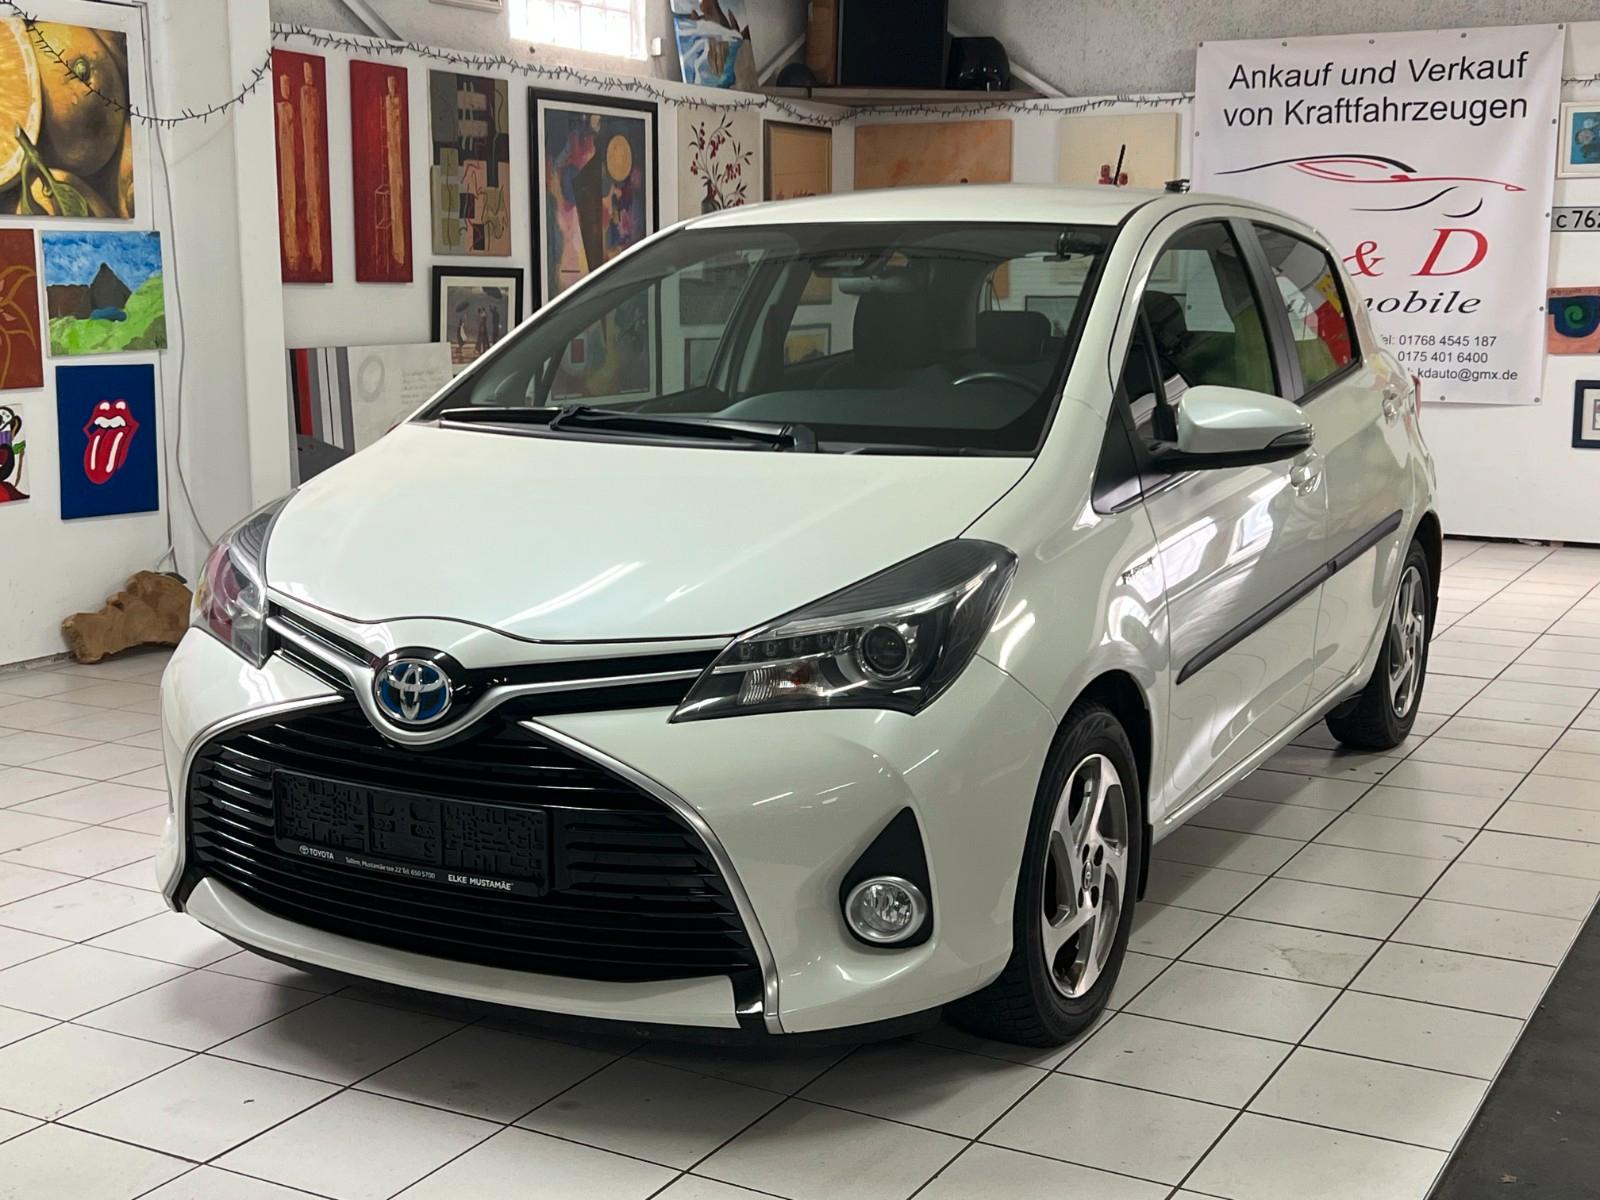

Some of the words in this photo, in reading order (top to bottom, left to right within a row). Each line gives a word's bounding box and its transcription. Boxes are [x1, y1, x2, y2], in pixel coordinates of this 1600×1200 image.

[1228, 62, 1334, 89] Ankauf
[1340, 60, 1397, 85] und
[1408, 51, 1529, 82] Verkauf
[1223, 106, 1273, 127] von
[1284, 96, 1527, 127] Kraftfahrzeugen
[1343, 240, 1386, 277] &
[1410, 228, 1488, 276] D
[1399, 334, 1436, 347] 01768
[1439, 335, 1470, 347] 4545
[1474, 336, 1497, 347] 187
[1398, 351, 1428, 362] 0175
[1431, 351, 1452, 363] 401
[1457, 352, 1488, 363] 6400
[1417, 368, 1518, 382] kdauto@gmx.de
[309, 848, 335, 860] TOYOTA
[447, 874, 468, 884] ELKE
